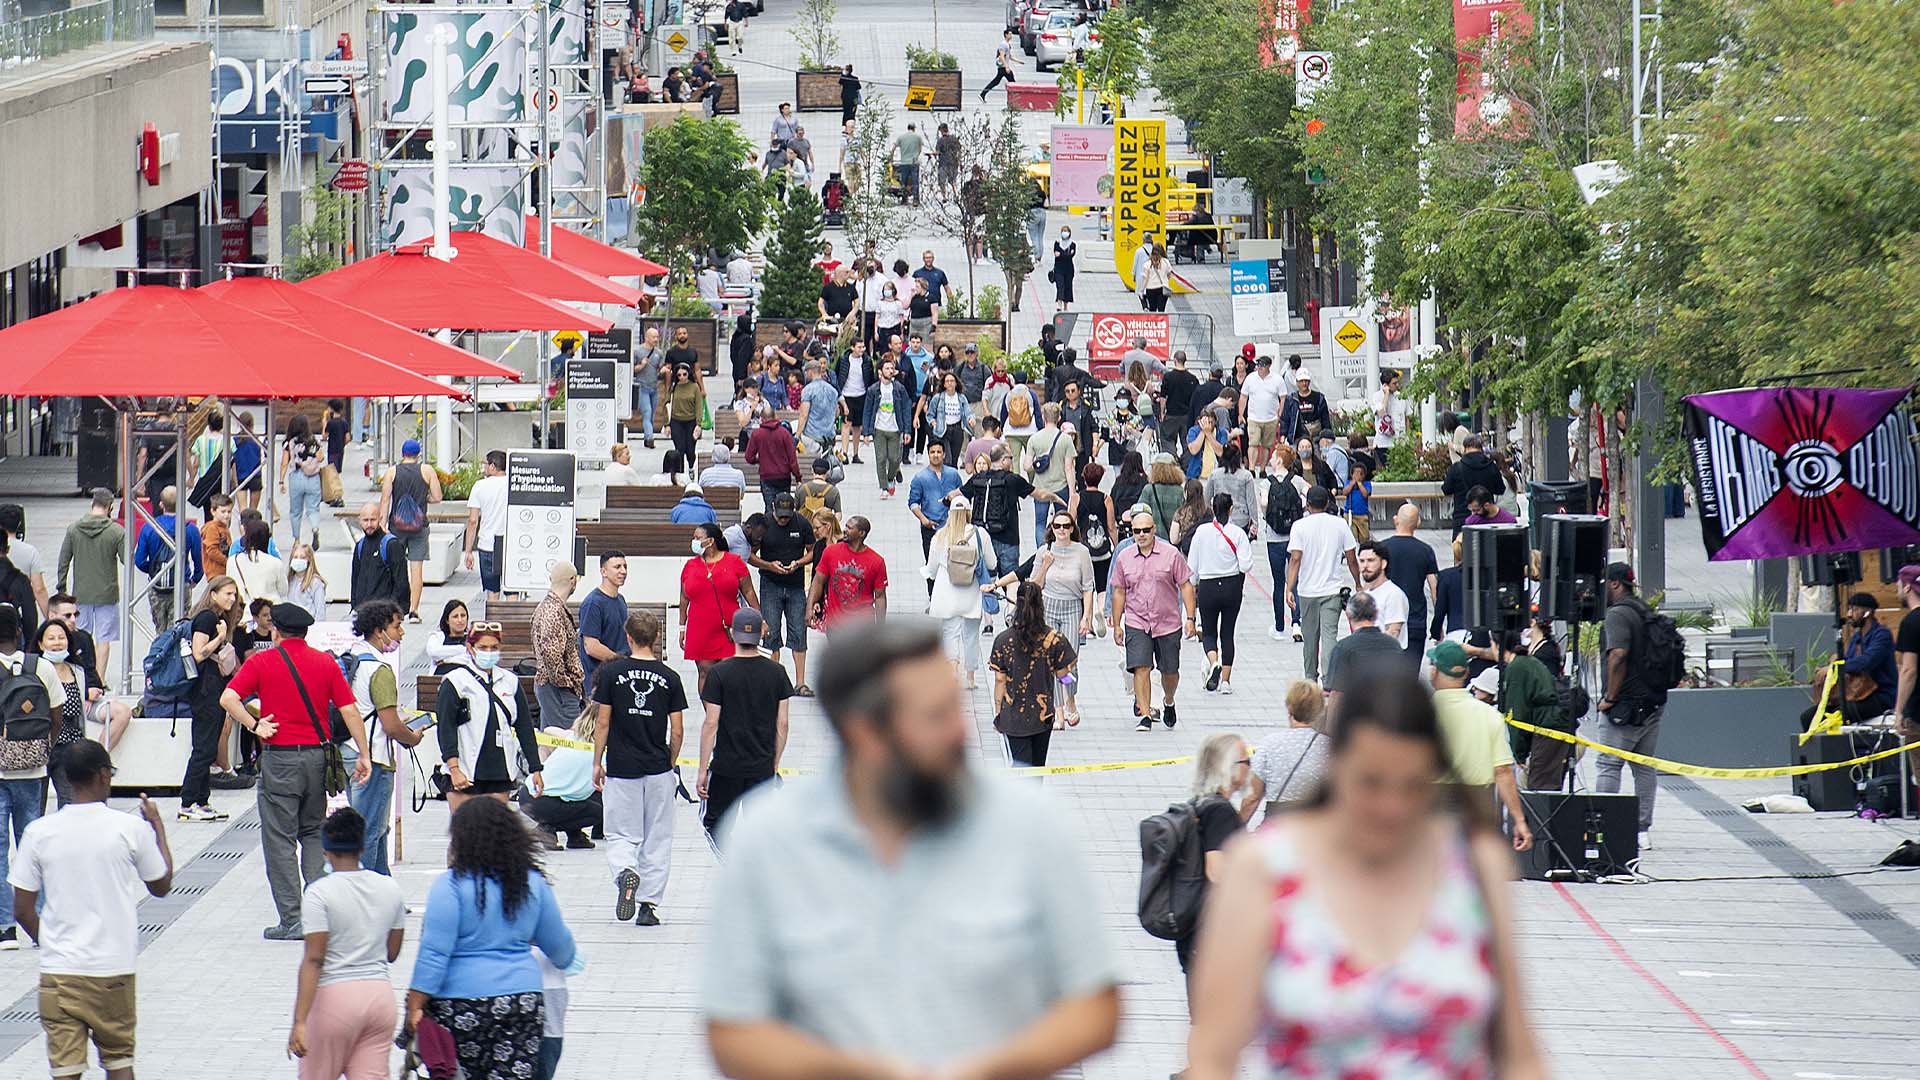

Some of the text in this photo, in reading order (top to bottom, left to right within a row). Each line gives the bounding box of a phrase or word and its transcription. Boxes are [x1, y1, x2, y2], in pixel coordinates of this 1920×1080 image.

[1121, 126, 1137, 220] PRENEZ
[1126, 329, 1166, 338] INTERDITS
[511, 466, 541, 475] Mesures
[1739, 432, 1781, 515] ARTS
[511, 475, 555, 484] d'hygiène et
[510, 483, 566, 493] de distanciation
